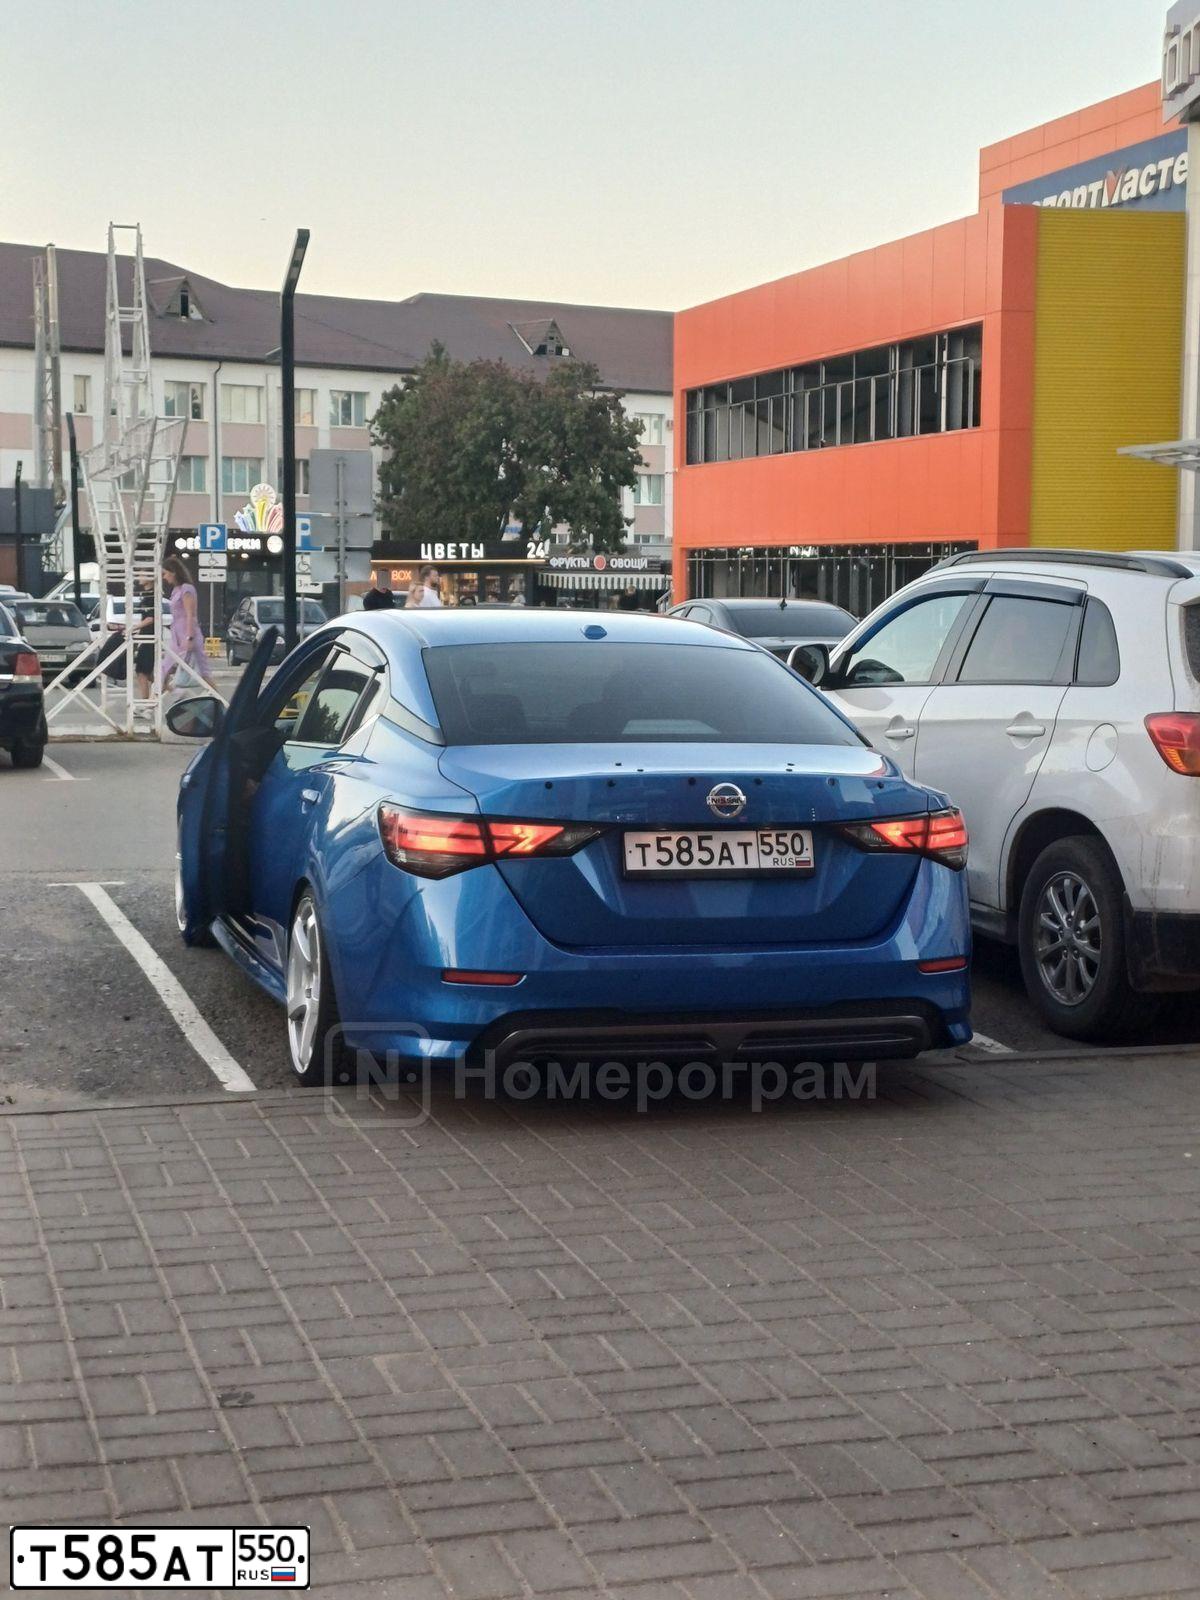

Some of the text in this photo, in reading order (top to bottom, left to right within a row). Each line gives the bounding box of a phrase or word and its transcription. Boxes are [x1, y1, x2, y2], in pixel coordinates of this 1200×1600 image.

[206, 526, 220, 548] P
[420, 542, 484, 560] ЦВЕТЫ
[550, 557, 648, 570] ФРУКТЫ ОВОЩИ
[391, 570, 412, 581] BOX
[635, 832, 804, 867] Т585АТ 550
[772, 857, 795, 867] RUS
